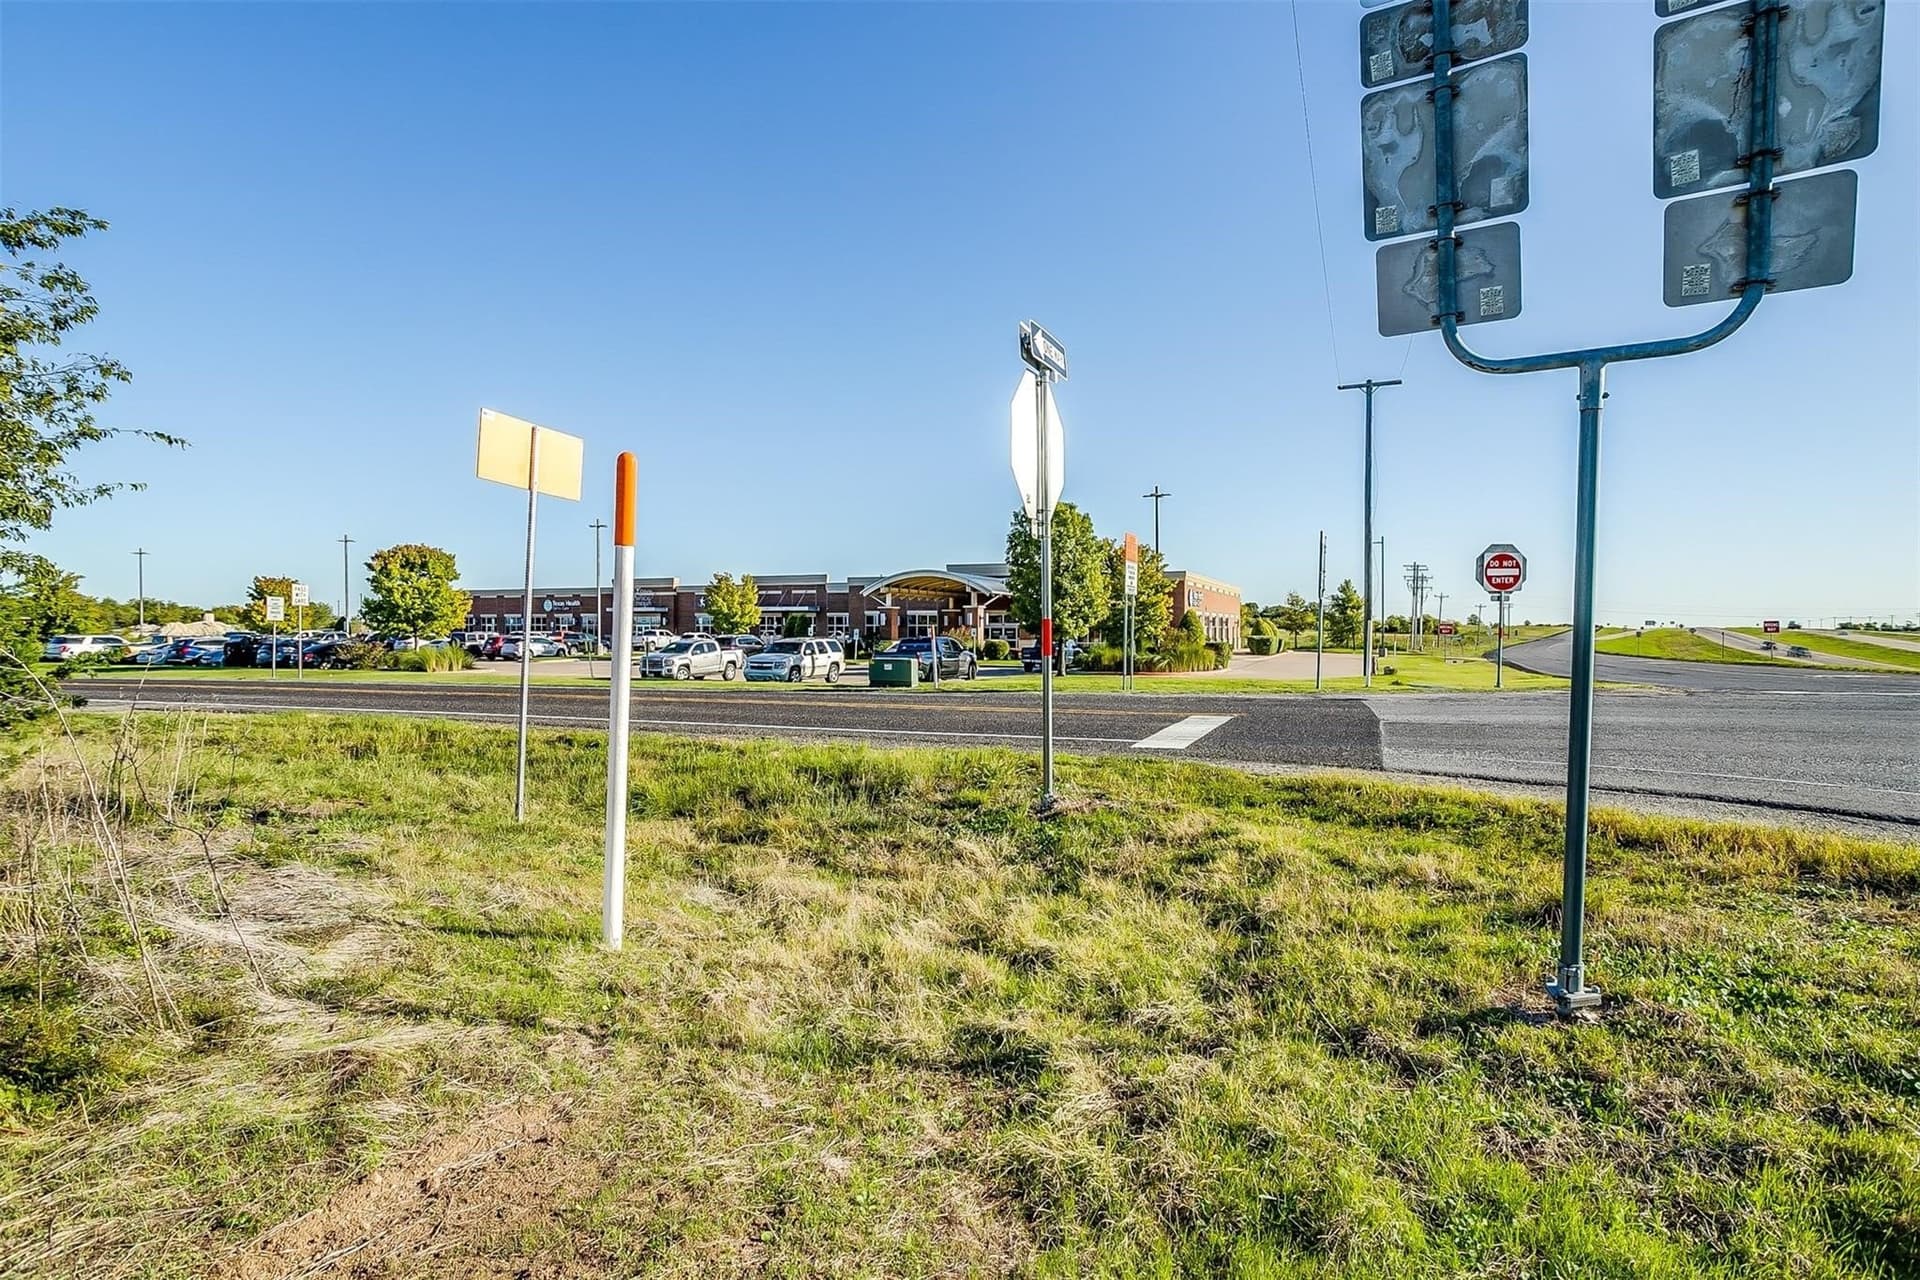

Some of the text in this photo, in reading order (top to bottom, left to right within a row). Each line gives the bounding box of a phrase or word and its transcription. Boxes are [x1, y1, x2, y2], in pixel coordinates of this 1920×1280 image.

[1042, 340, 1053, 358] ONE
[1492, 576, 1514, 584] ENTER
[566, 599, 581, 607] Health
